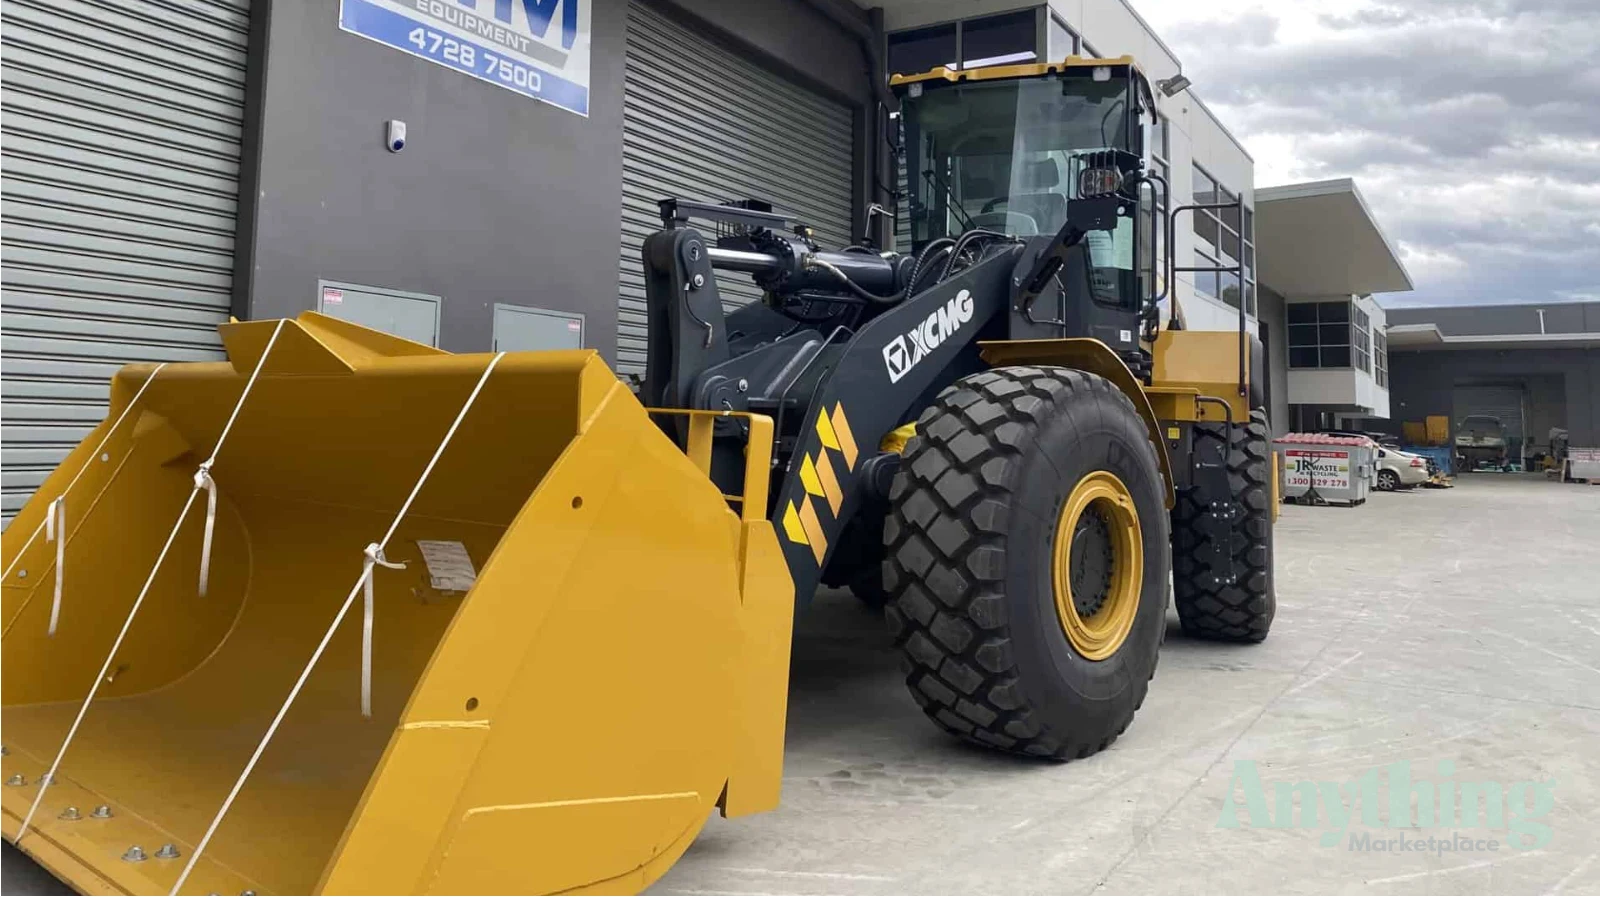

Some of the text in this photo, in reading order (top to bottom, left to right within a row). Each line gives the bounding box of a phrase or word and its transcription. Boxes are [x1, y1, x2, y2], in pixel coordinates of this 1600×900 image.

[416, 0, 530, 52] EQUIPMENT
[409, 28, 542, 92] 4728 7500
[907, 289, 974, 367] XCMG
[1295, 460, 1312, 472] JR
